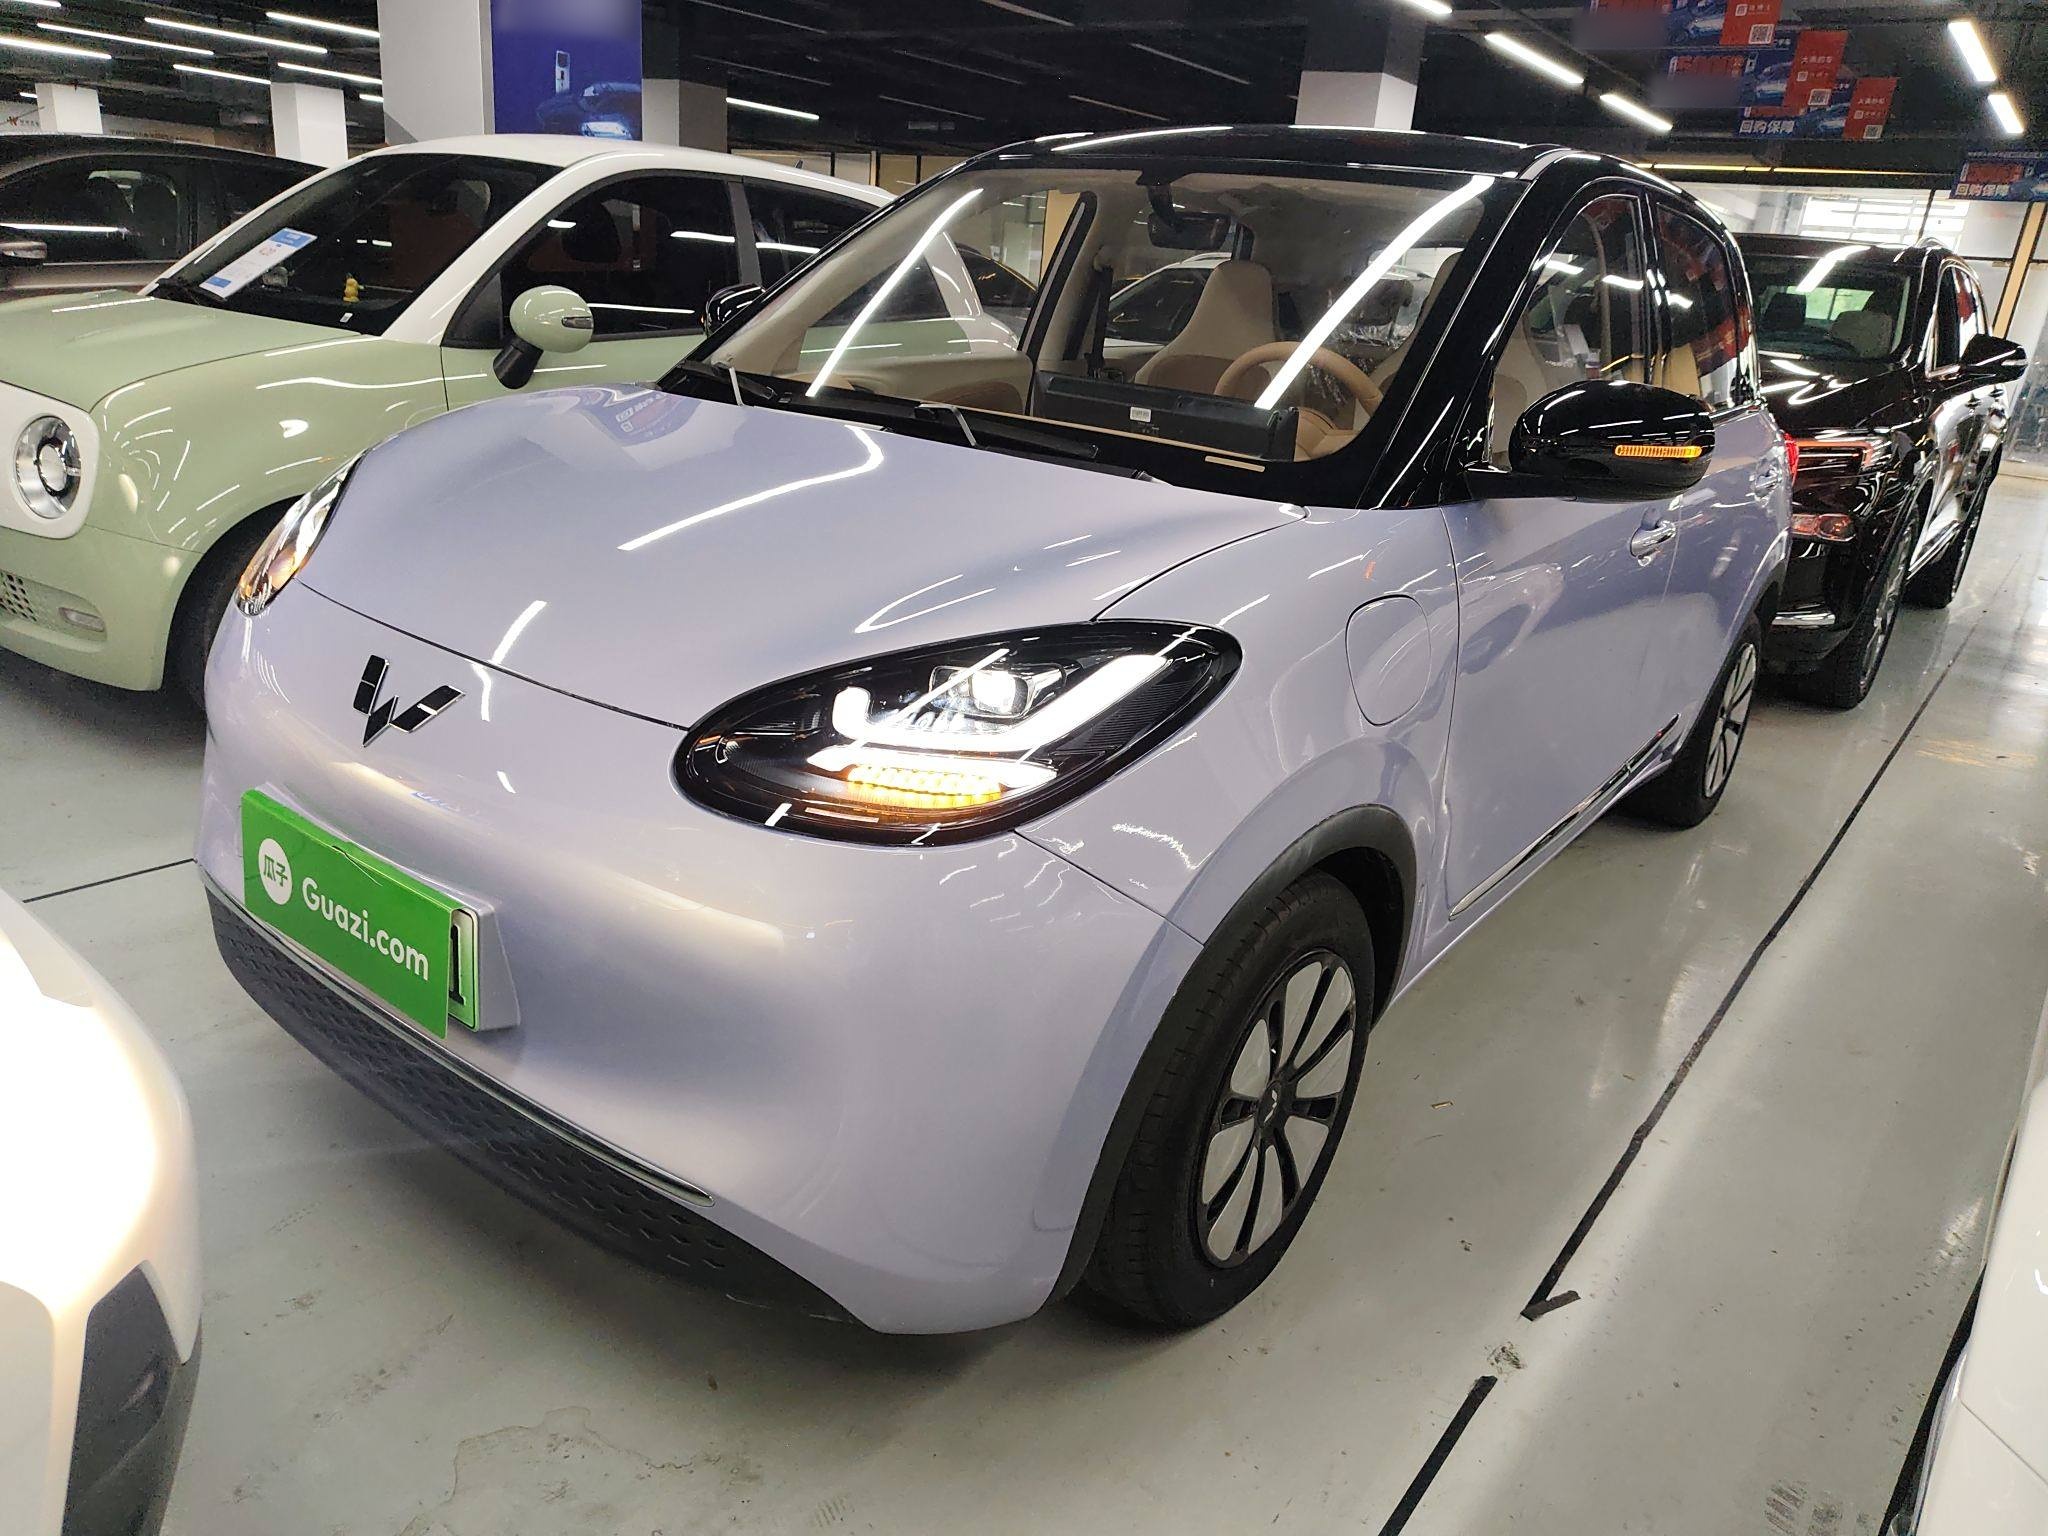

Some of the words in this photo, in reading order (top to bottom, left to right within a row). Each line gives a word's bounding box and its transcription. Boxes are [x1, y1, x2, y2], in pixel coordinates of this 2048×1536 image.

[1739, 120, 1795, 134] 回购保障
[263, 854, 289, 888] 瓜子
[302, 877, 429, 982] Guazi.com
